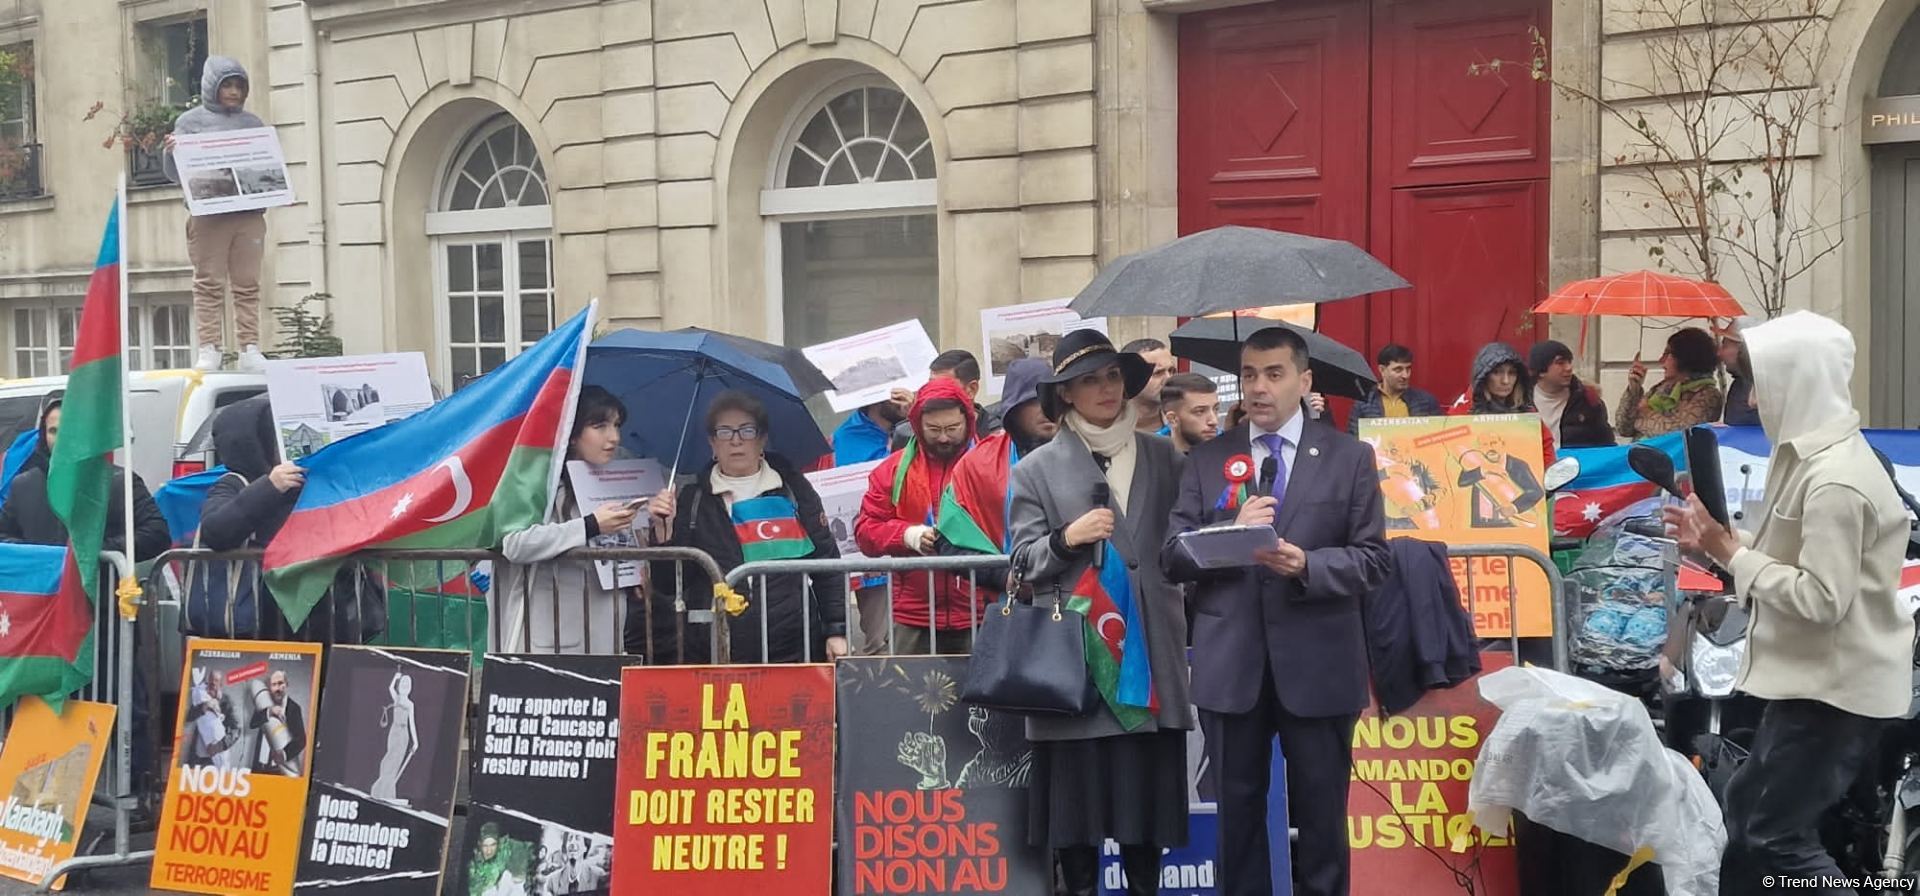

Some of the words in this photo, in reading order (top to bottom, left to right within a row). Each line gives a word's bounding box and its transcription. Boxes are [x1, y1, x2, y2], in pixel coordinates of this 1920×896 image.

[1482, 556, 1507, 575] le
[489, 694, 523, 714] Pour
[524, 697, 590, 717] apporter
[592, 696, 607, 717] la
[702, 683, 750, 730] LA
[487, 714, 518, 734] Paix
[520, 718, 539, 735] au
[541, 716, 606, 738] Caucase
[609, 718, 619, 738] d
[1351, 715, 1479, 749] NOUS
[484, 734, 513, 754] Sud
[515, 735, 530, 755] la
[532, 736, 582, 758] France
[585, 739, 616, 759] doit
[645, 730, 802, 779] FRANCE
[178, 763, 252, 797] NOUS
[482, 757, 528, 776] rester
[529, 759, 580, 779] neutre
[1350, 758, 1475, 781] MANDO
[175, 794, 268, 829] DISONS
[318, 794, 359, 820] Nous
[629, 789, 696, 825] DOIT
[706, 788, 815, 824] RESTER
[854, 788, 965, 824] NOUS
[1390, 781, 1449, 814] LA
[170, 825, 229, 855] NON
[231, 829, 270, 860] AU
[314, 818, 410, 848] demandons
[854, 822, 1000, 860] DISONS
[310, 839, 328, 862] la
[328, 841, 394, 869] justice!
[652, 834, 765, 871] NEUTRE
[776, 834, 788, 870] !
[164, 862, 272, 891] TERRORISME
[855, 858, 946, 894] NON
[951, 857, 1008, 893] AU
